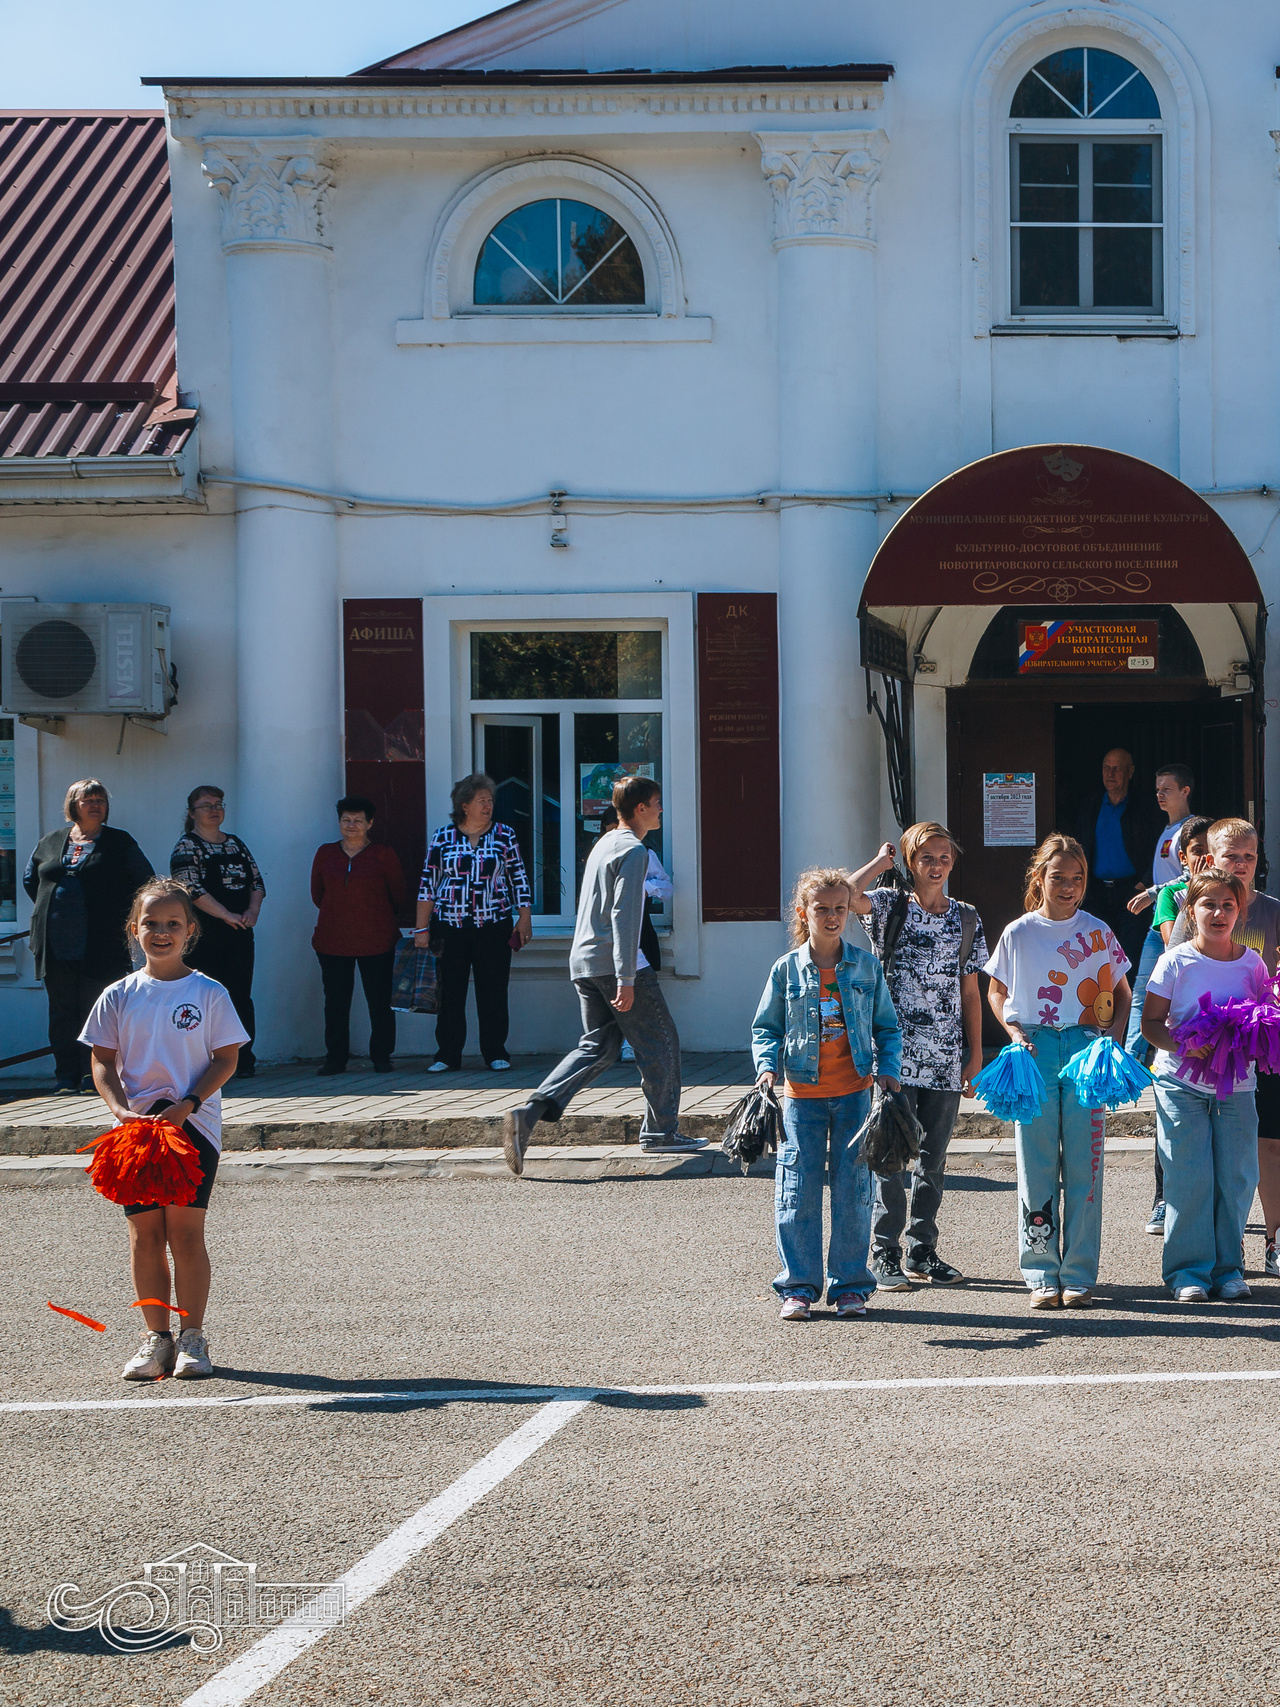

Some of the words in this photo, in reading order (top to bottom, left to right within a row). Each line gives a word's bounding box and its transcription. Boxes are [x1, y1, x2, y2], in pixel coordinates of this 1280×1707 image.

[910, 515, 1006, 525] МУНИЦИПАЛЬНОЕ
[1009, 514, 1077, 524] БЮДЖЕТНОЕ
[1079, 514, 1151, 524] УЧРЕЖДЕНИЕ
[1153, 513, 1209, 523] КУЛЬТУРЫ
[955, 543, 1081, 553] КУЛЬТУРНО-ДОСУГОВОЕ
[1082, 543, 1162, 553] ОБЪЕДИНЕНИЕ
[939, 561, 1050, 570] НОВОТИТАРОВСКОГО
[1052, 560, 1112, 569] СЕЛЬСКОГО
[1115, 560, 1179, 569] ПОСЕЛЕНИЯ
[349, 627, 416, 640] АФИША
[1068, 625, 1137, 634] УЧАСТКОВАЯ
[1057, 635, 1148, 644] ИЗБИРАТЕЛЬНАЯ
[1072, 646, 1132, 654] КОМИССИЯ
[116, 624, 134, 696] VESTEL
